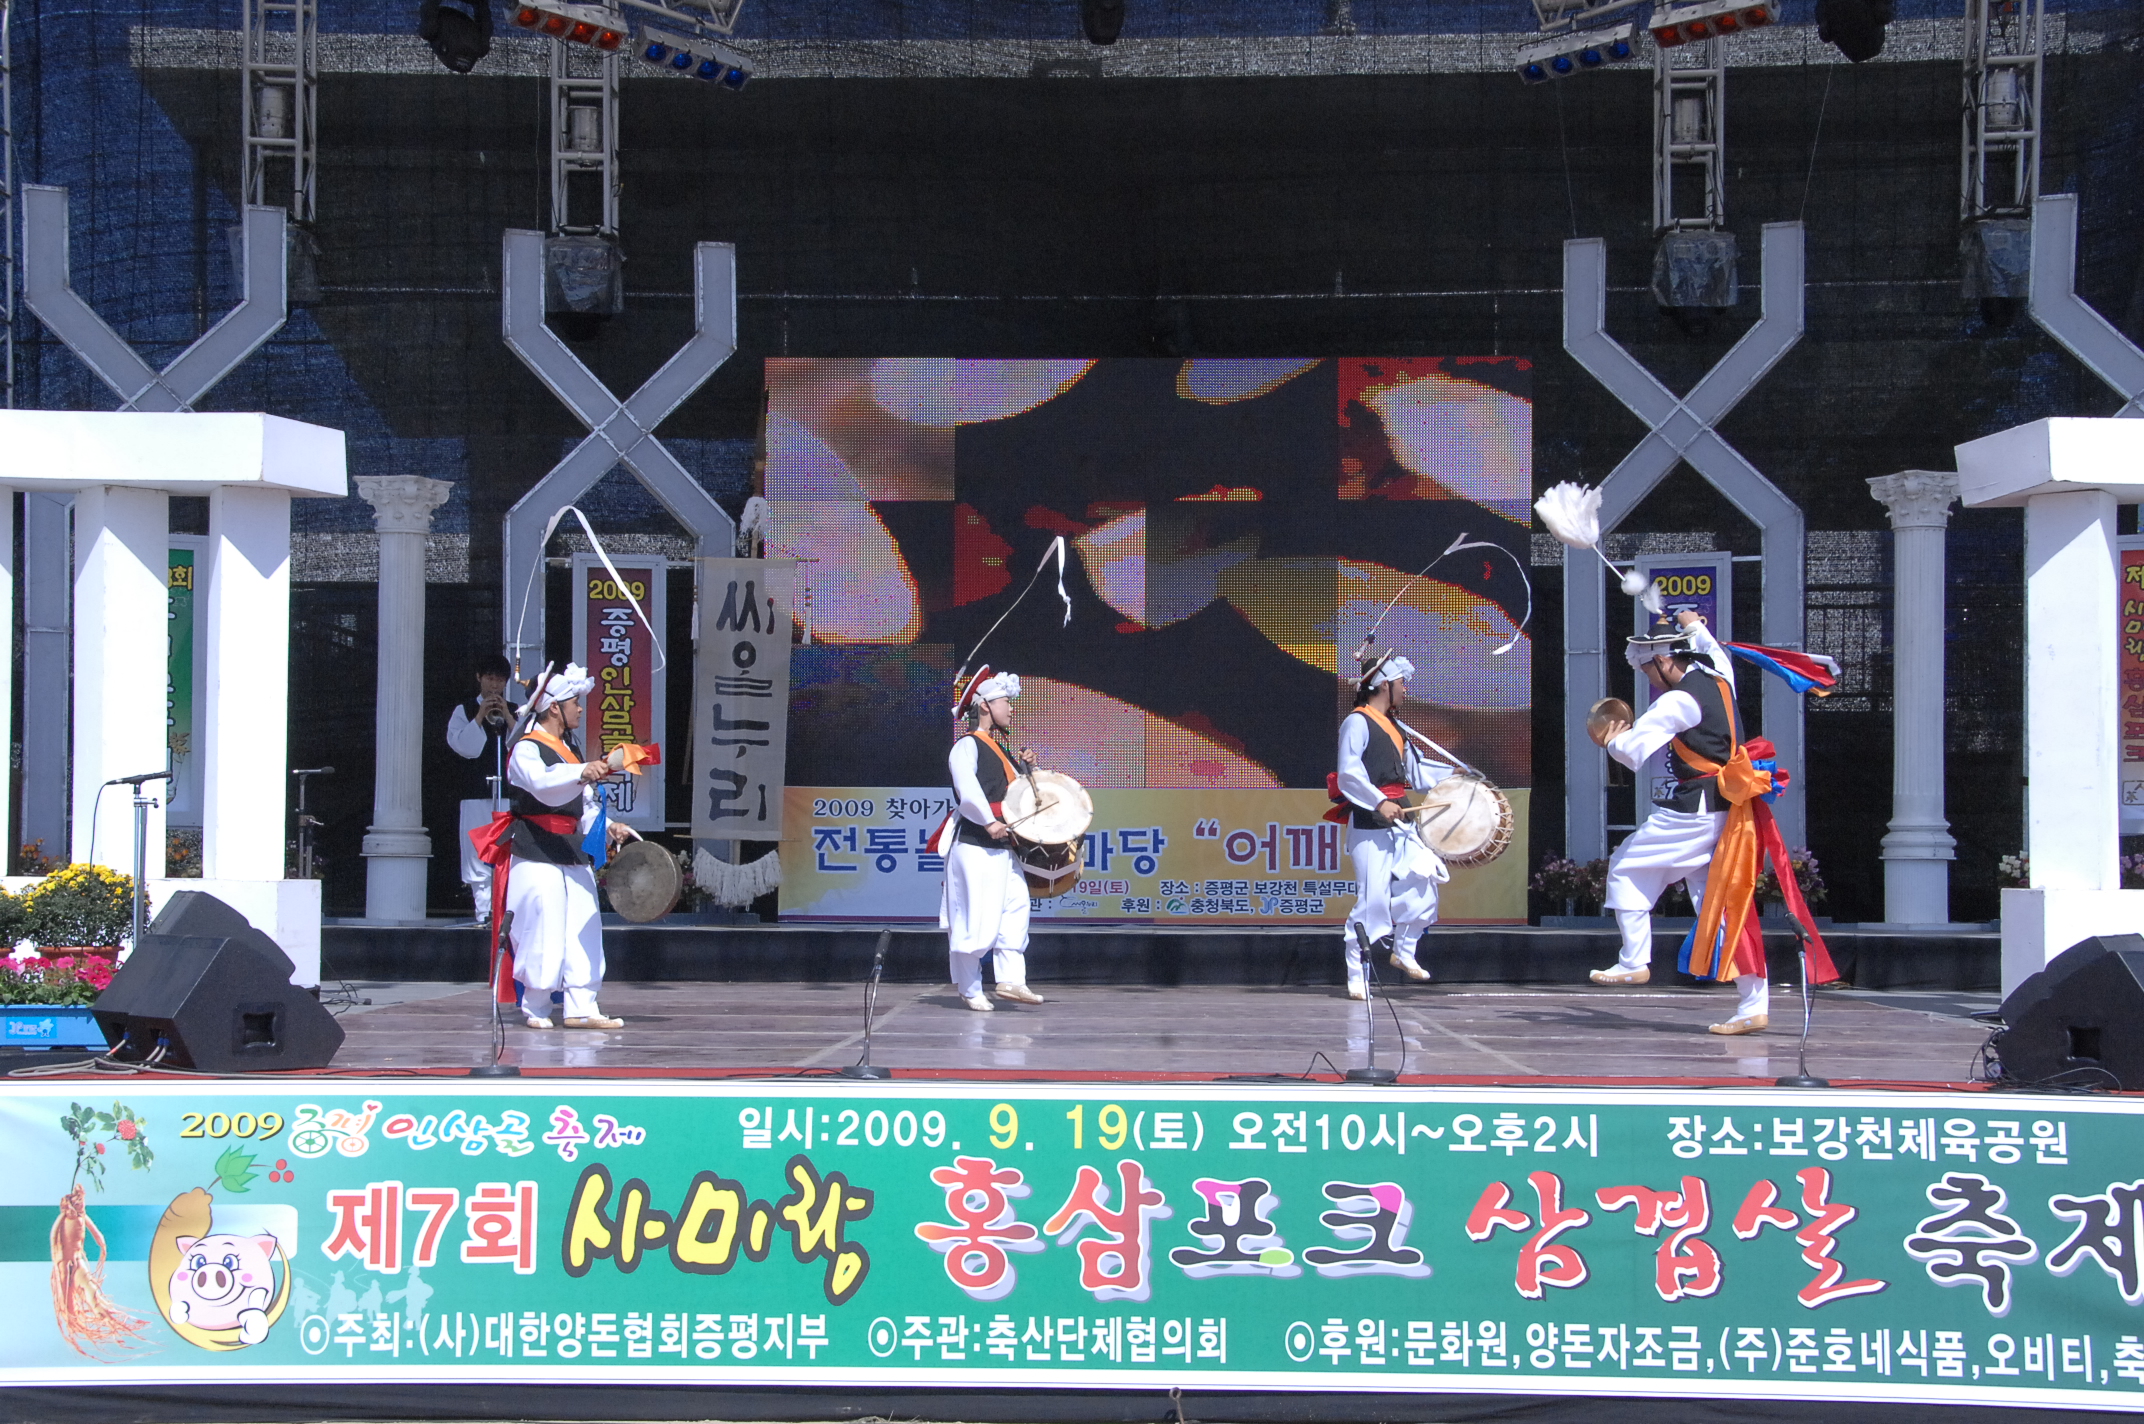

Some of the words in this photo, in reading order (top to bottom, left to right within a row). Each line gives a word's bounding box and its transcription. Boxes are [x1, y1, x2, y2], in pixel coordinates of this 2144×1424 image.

[589, 579, 645, 601] 2009
[1654, 575, 1711, 596] 2009
[813, 799, 874, 817] 2009
[1160, 881, 1190, 895] 장소
[1204, 881, 1249, 896] 증평군
[1254, 881, 1297, 896] 보강천
[1121, 898, 1150, 913] 후원
[1280, 898, 1324, 914] 증평군
[179, 1112, 285, 1140] 2009
[738, 1106, 961, 1150] 일시:2009.
[1066, 1103, 1205, 1152] 19(토)
[1667, 1116, 2069, 1166] 장소:보강천체육공원
[322, 1180, 540, 1276] 제7회
[1465, 1166, 1892, 1310] 삼겹살
